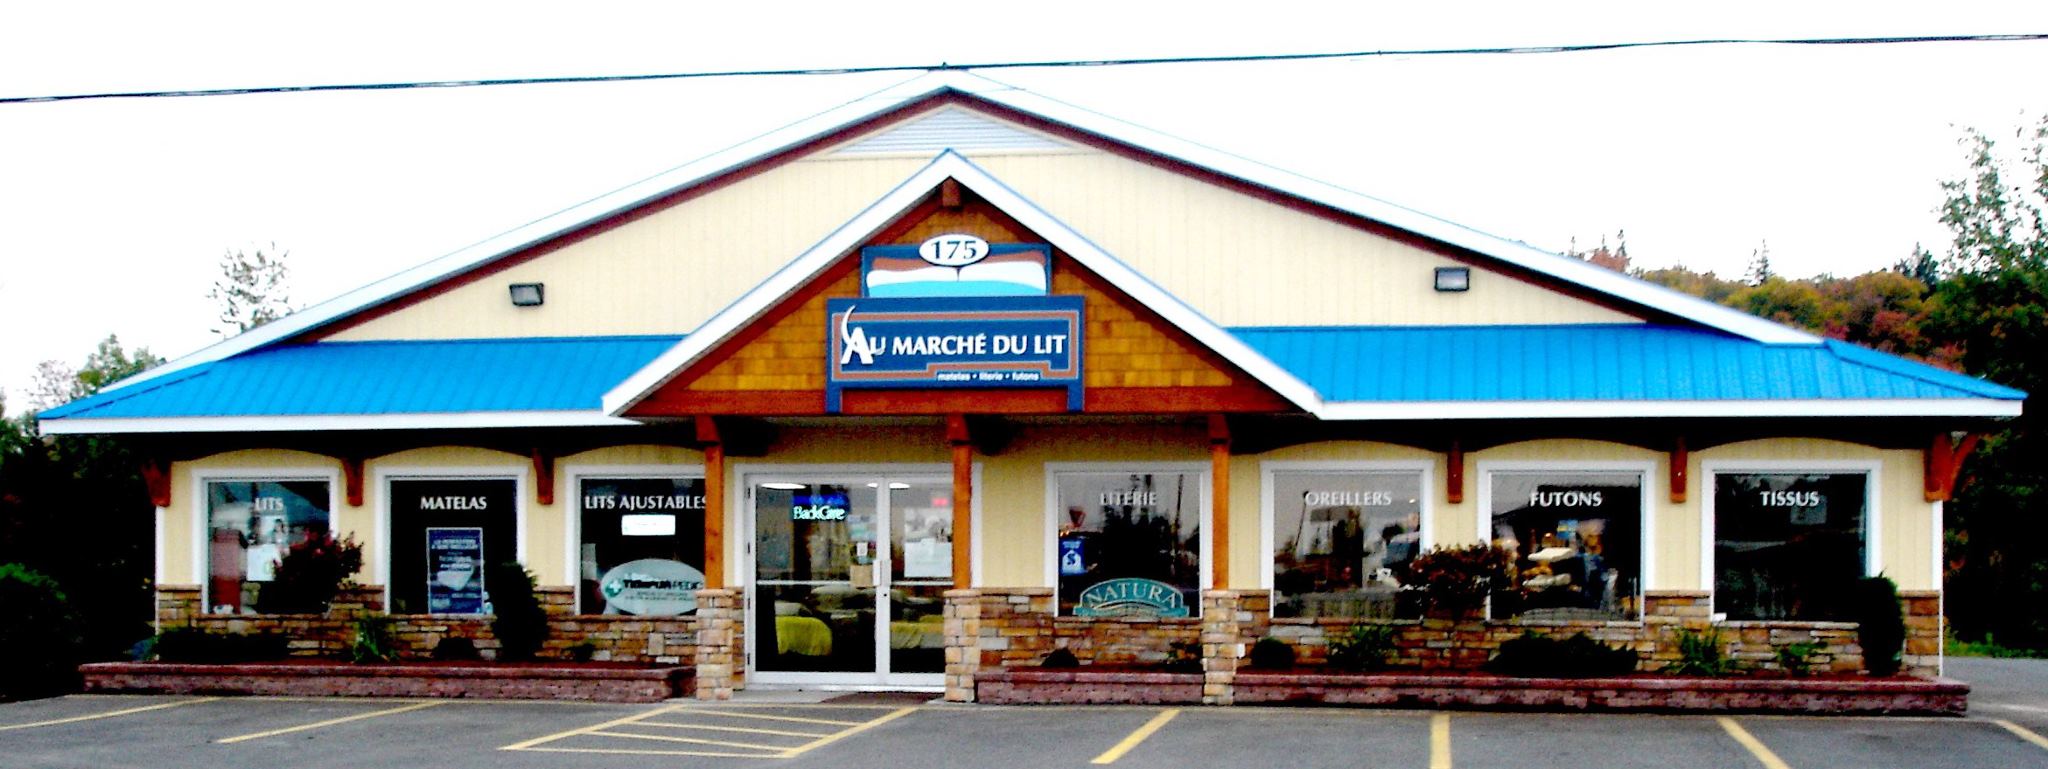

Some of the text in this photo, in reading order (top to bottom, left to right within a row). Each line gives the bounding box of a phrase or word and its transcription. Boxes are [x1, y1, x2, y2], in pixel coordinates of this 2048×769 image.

[930, 240, 977, 260] 175
[892, 333, 986, 355] MARCHÉ
[993, 335, 1027, 355] DU
[1034, 335, 1067, 354] LIT
[254, 497, 284, 511] LITS
[420, 496, 487, 510] MATELAS
[584, 495, 616, 510] LITS
[1100, 491, 1157, 506] LITERIE
[1305, 491, 1392, 507] OREILLERS
[1529, 491, 1603, 507] FUTONS
[1760, 490, 1820, 507] TISSUS
[1086, 583, 1177, 608] NATURA
